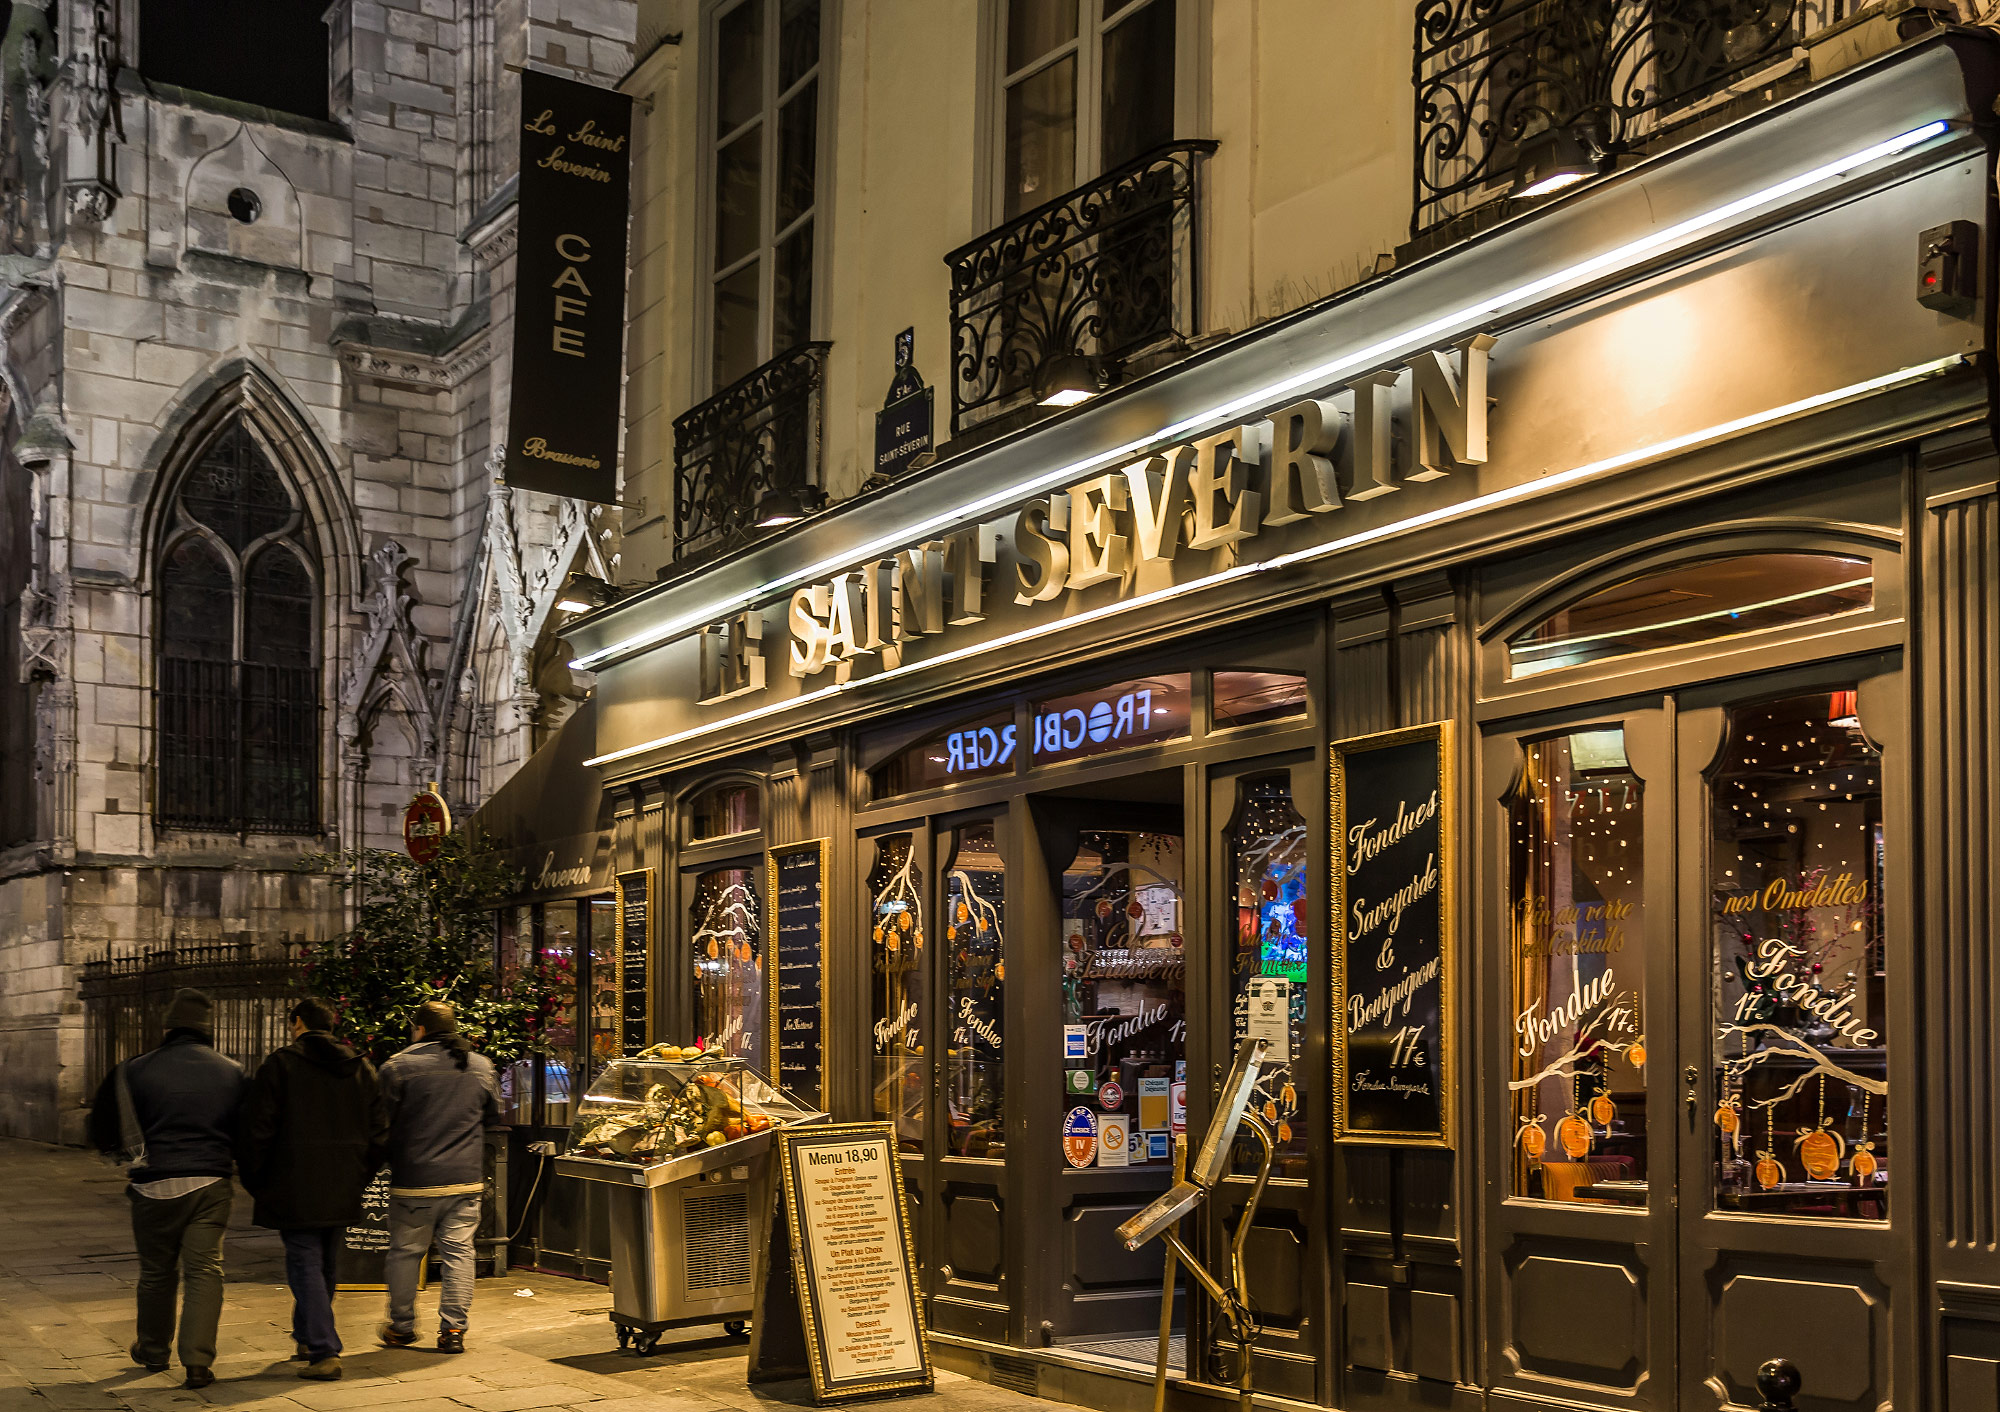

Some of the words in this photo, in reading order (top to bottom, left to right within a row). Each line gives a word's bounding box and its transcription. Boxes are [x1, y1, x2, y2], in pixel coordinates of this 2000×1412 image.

[523, 109, 557, 138] Le
[567, 119, 627, 154] Saint
[537, 145, 612, 184] Severin
[552, 233, 592, 358] CAFE
[895, 421, 911, 437] RUE
[521, 436, 601, 471] Brasserie
[879, 434, 929, 466] SAINT-SÉVERIN
[697, 610, 768, 706] LE
[789, 523, 998, 677] SAINT
[1015, 334, 1499, 606] SEVERIN
[1347, 789, 1438, 875] Fondues
[532, 850, 593, 890] Severin
[1349, 853, 1438, 942] Savoyarde
[1555, 907, 1580, 925] au
[1585, 898, 1635, 922] verre
[1723, 887, 1758, 914] nos
[1766, 875, 1868, 912] Omelettes
[1375, 938, 1395, 972] &
[1548, 925, 1625, 956] Cocktails
[1516, 967, 1616, 1057] Fondue
[1745, 938, 1879, 1048] Fondue
[874, 999, 918, 1054] Fondue
[958, 996, 1002, 1049] Fondue
[1087, 999, 1168, 1055] Fondue
[808, 1152, 842, 1165] Menu
[845, 1148, 878, 1164] 18,90
[1076, 1140, 1085, 1149] IV
[834, 1167, 856, 1175] Entrée
[865, 1246, 883, 1254] Choix
[855, 1320, 881, 1328] Dessert
